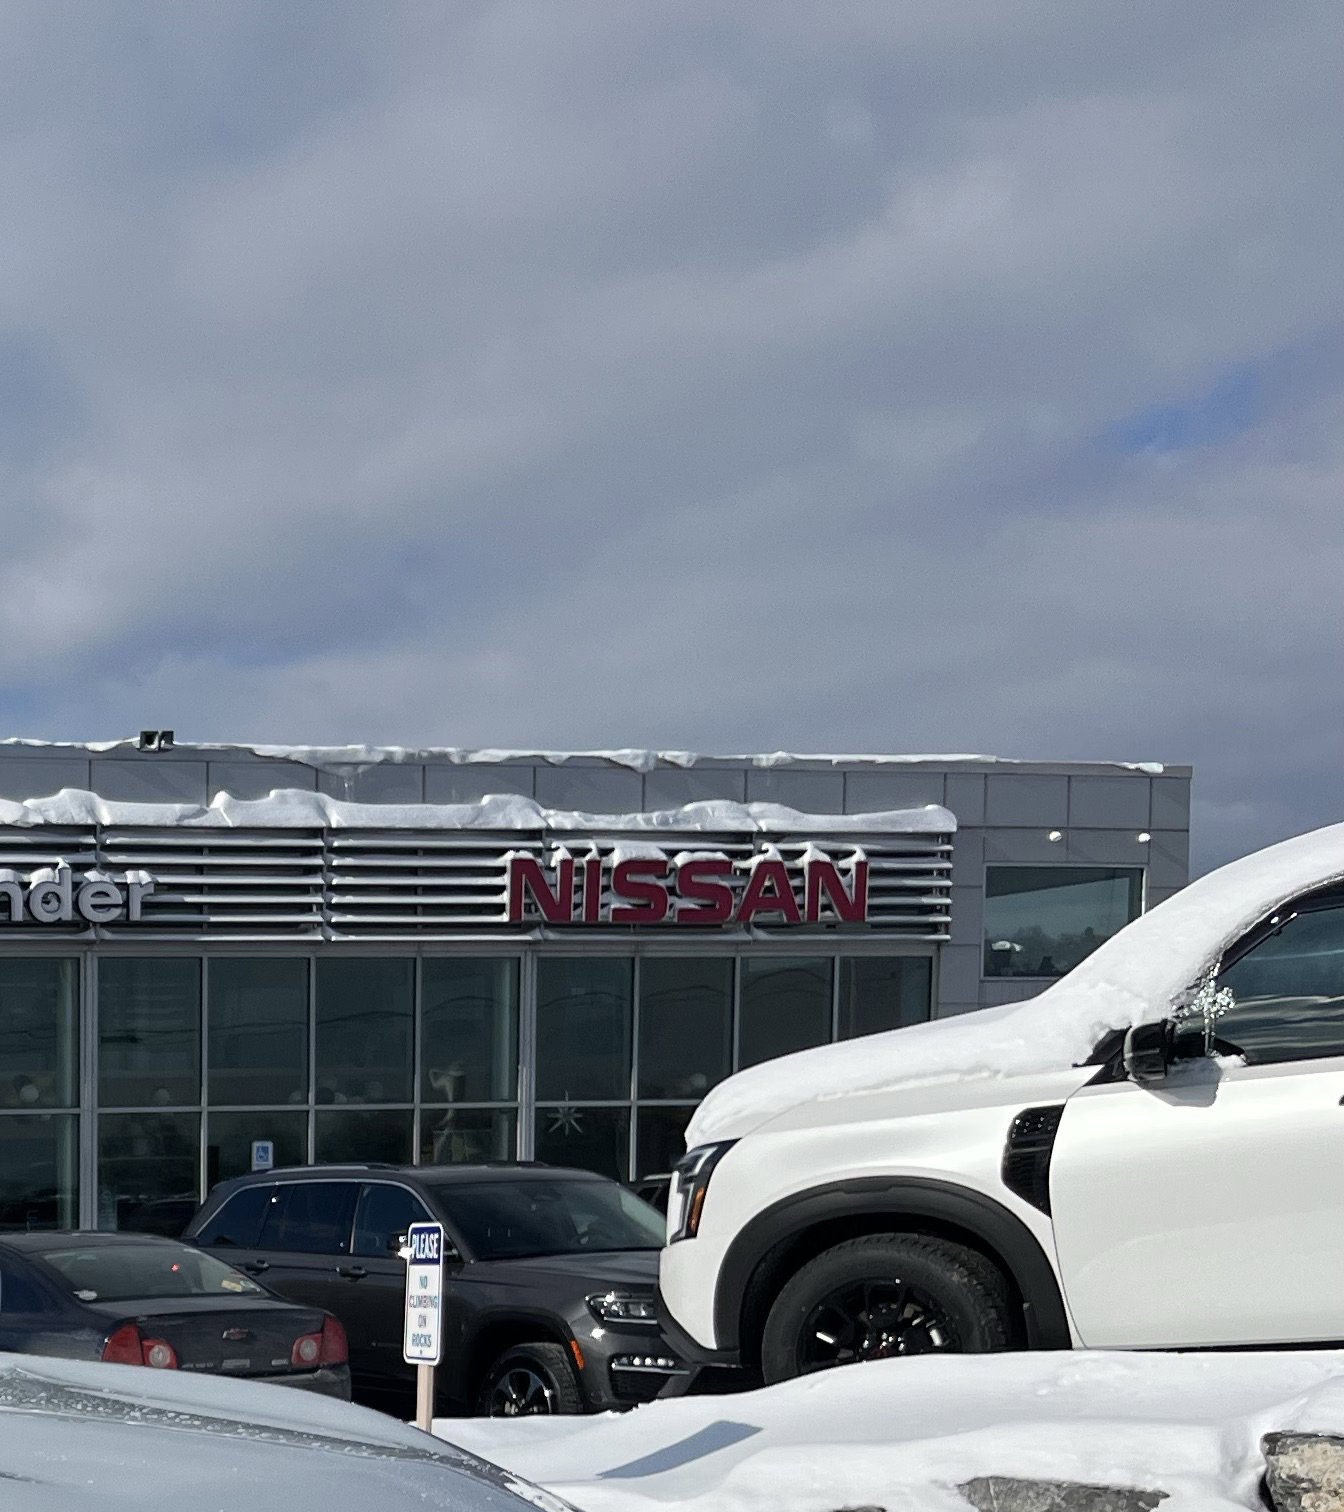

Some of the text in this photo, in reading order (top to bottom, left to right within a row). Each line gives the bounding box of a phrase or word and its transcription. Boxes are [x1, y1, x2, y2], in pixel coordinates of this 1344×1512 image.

[509, 858, 870, 924] NISSAN
[411, 1232, 440, 1259] PLEASE
[419, 1275, 429, 1290] NO
[408, 1295, 439, 1309] CLIMBING
[417, 1314, 428, 1328] ON
[411, 1333, 433, 1349] ROCKS
